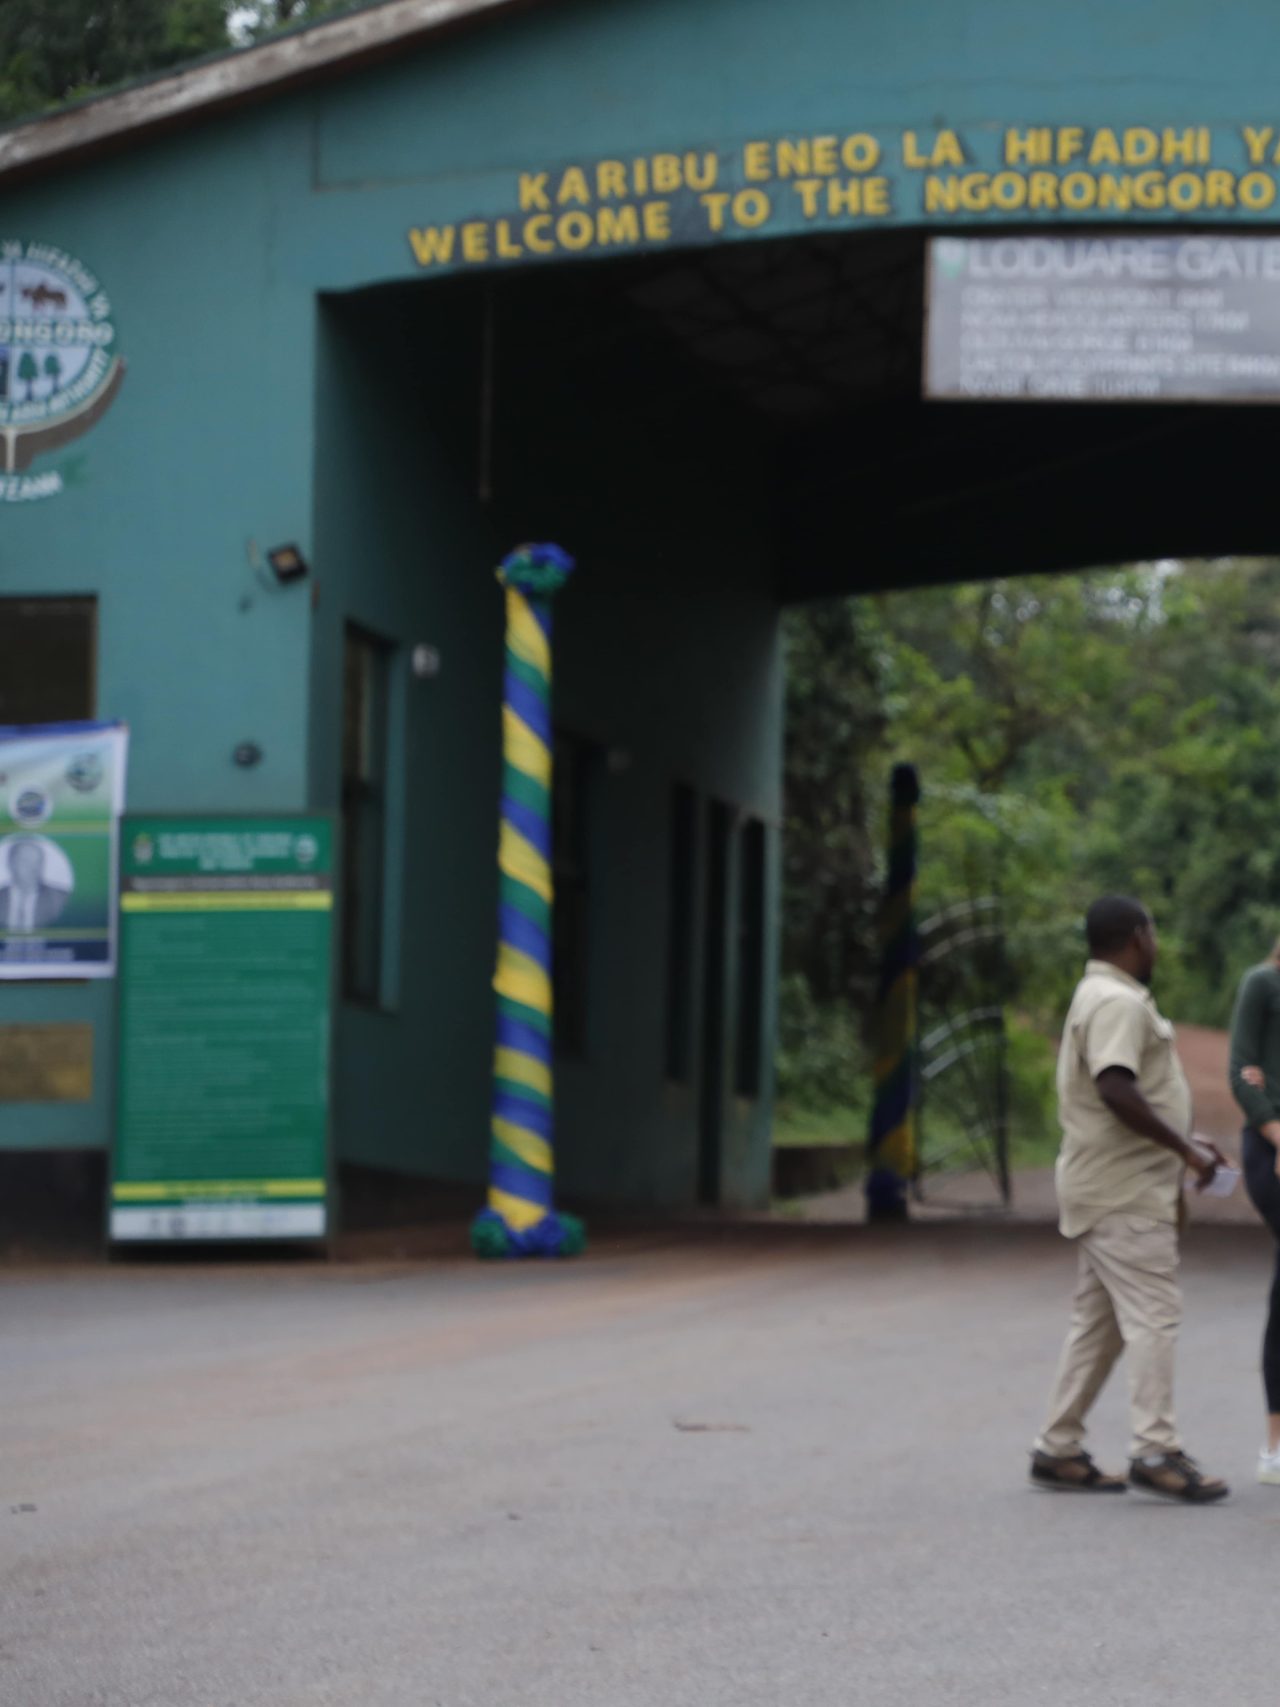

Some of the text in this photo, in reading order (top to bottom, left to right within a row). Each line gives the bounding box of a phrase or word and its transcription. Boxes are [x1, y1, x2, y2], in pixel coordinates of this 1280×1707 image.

[518, 150, 719, 211] KARIBU
[743, 132, 881, 182] ENEO
[902, 129, 965, 169] LA
[1003, 126, 1211, 167] HIFADHI
[408, 200, 672, 267] WELCOME
[702, 187, 770, 232] TO
[794, 175, 890, 219] THE
[924, 169, 1277, 213] NGORONGORO
